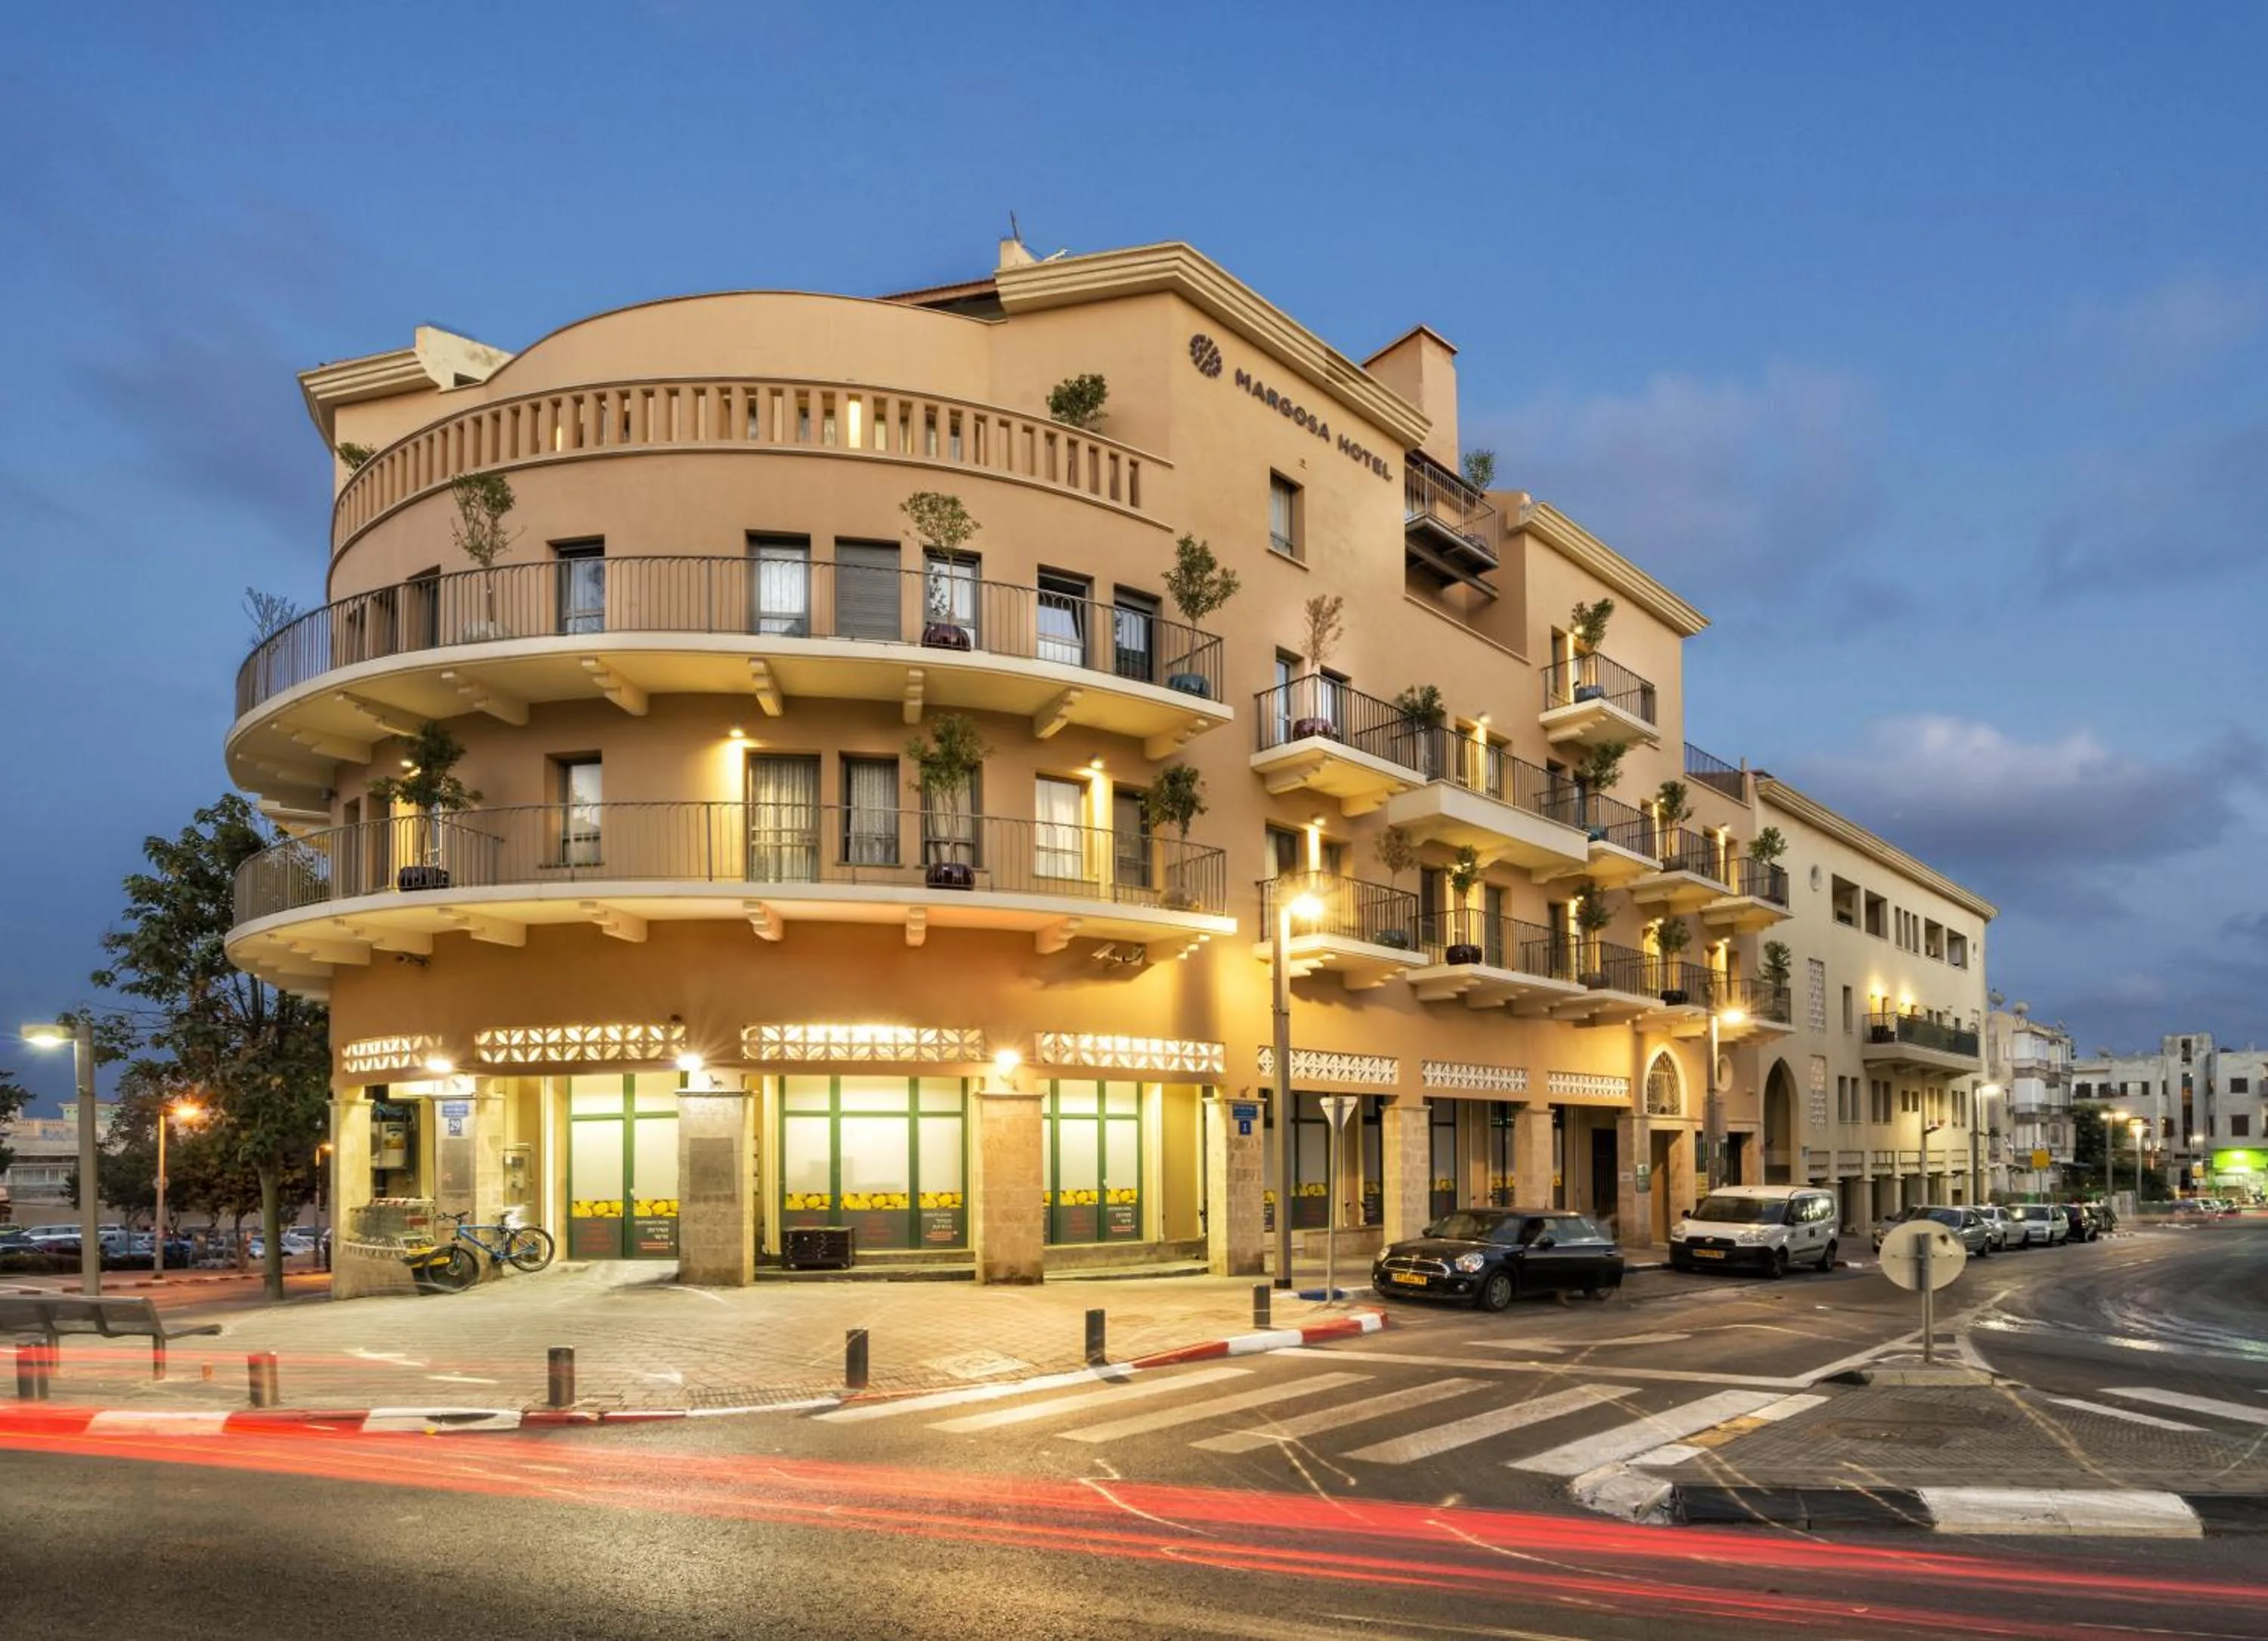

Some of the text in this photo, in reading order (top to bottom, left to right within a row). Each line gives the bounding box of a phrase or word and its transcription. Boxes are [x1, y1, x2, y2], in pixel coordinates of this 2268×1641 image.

[1235, 368, 1393, 482] MARGOSA HOTEL
[450, 1120, 460, 1131] 29
